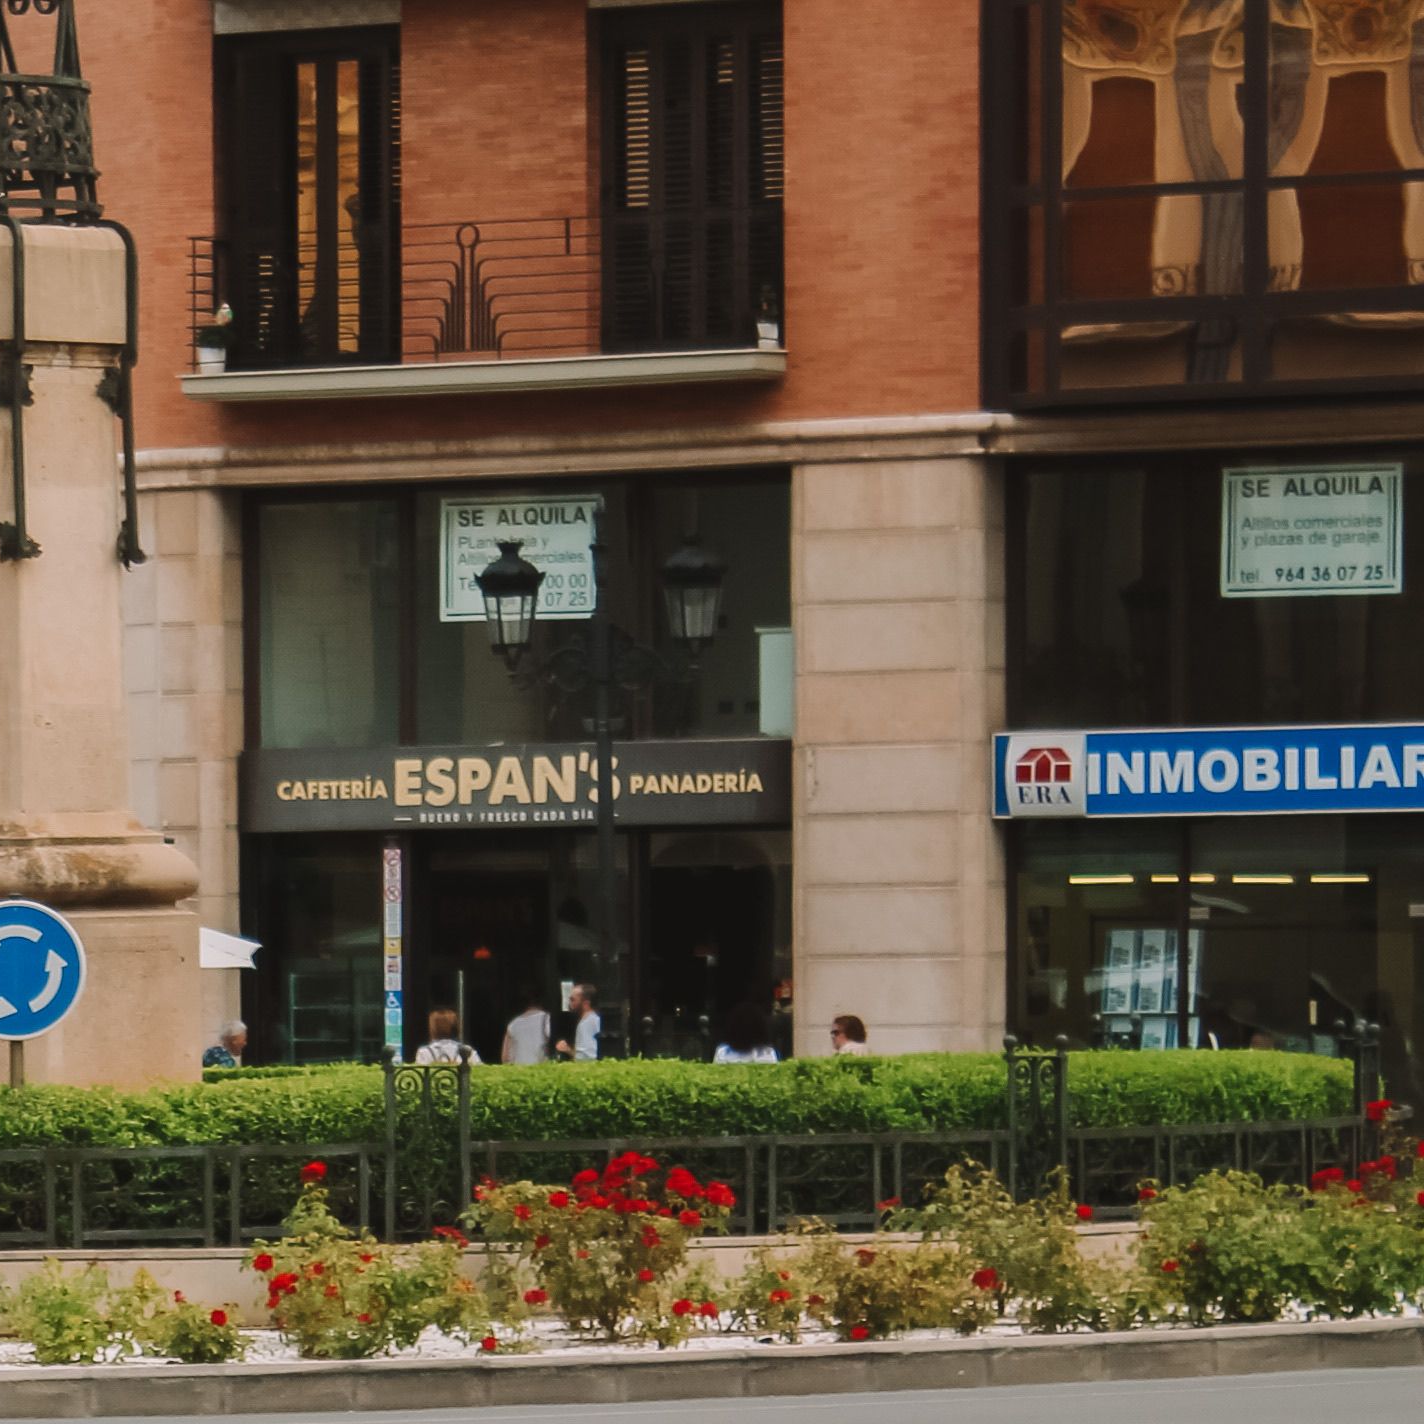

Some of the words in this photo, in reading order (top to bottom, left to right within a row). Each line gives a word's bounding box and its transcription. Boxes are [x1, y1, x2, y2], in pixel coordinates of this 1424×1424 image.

[1241, 479, 1271, 498] SE
[1283, 475, 1385, 497] ALQUILA
[458, 509, 485, 528] SE
[496, 506, 588, 527] ALQUILA
[1293, 513, 1383, 530] comerciales
[1253, 533, 1303, 548] plazas
[1308, 531, 1328, 545] de
[546, 575, 564, 589] 00
[569, 574, 587, 588] 00
[1275, 567, 1305, 583] 964
[1311, 566, 1332, 582] 36
[1337, 566, 1357, 581] 07
[1364, 565, 1383, 580] 25
[545, 592, 563, 607] 07
[568, 592, 587, 606] 25
[277, 774, 389, 801] CAFETERÍA
[629, 768, 764, 794] PANADERÍA
[1018, 784, 1073, 805] ERA
[466, 812, 474, 822] Y
[479, 811, 528, 823] FRESCO
[533, 810, 566, 822] CADA
[571, 809, 594, 821] DÍA
